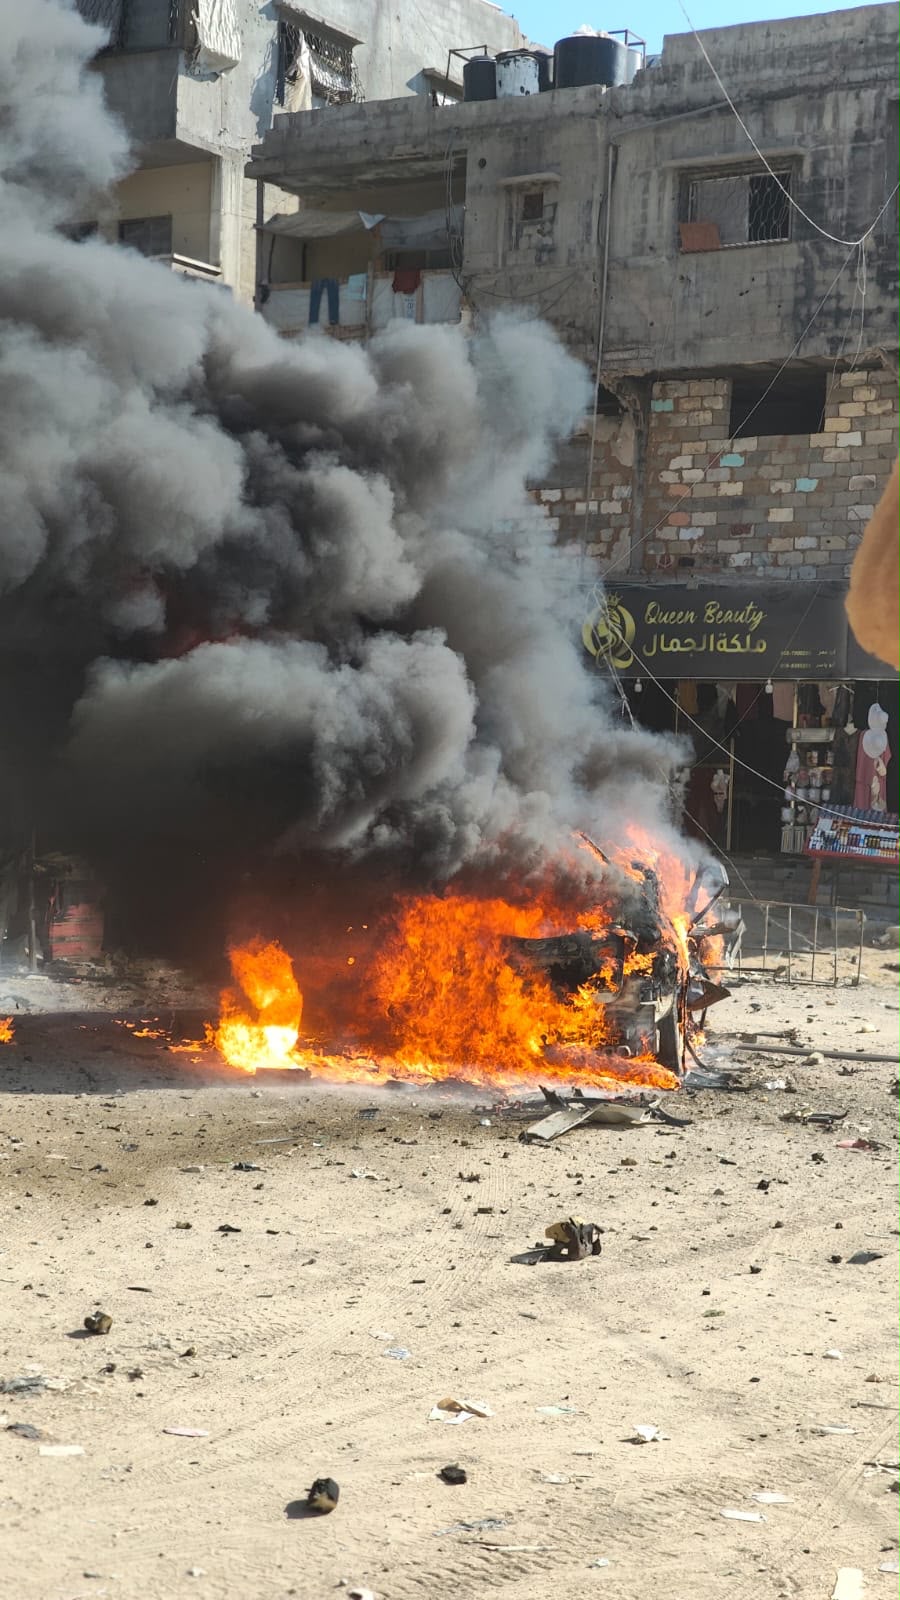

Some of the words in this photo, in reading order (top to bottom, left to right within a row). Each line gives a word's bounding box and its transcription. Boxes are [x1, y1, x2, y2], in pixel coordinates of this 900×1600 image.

[645, 601, 697, 624] Queen
[704, 601, 767, 631] Beauty
[643, 633, 714, 657] الجمال
[716, 633, 767, 653] ملكة
